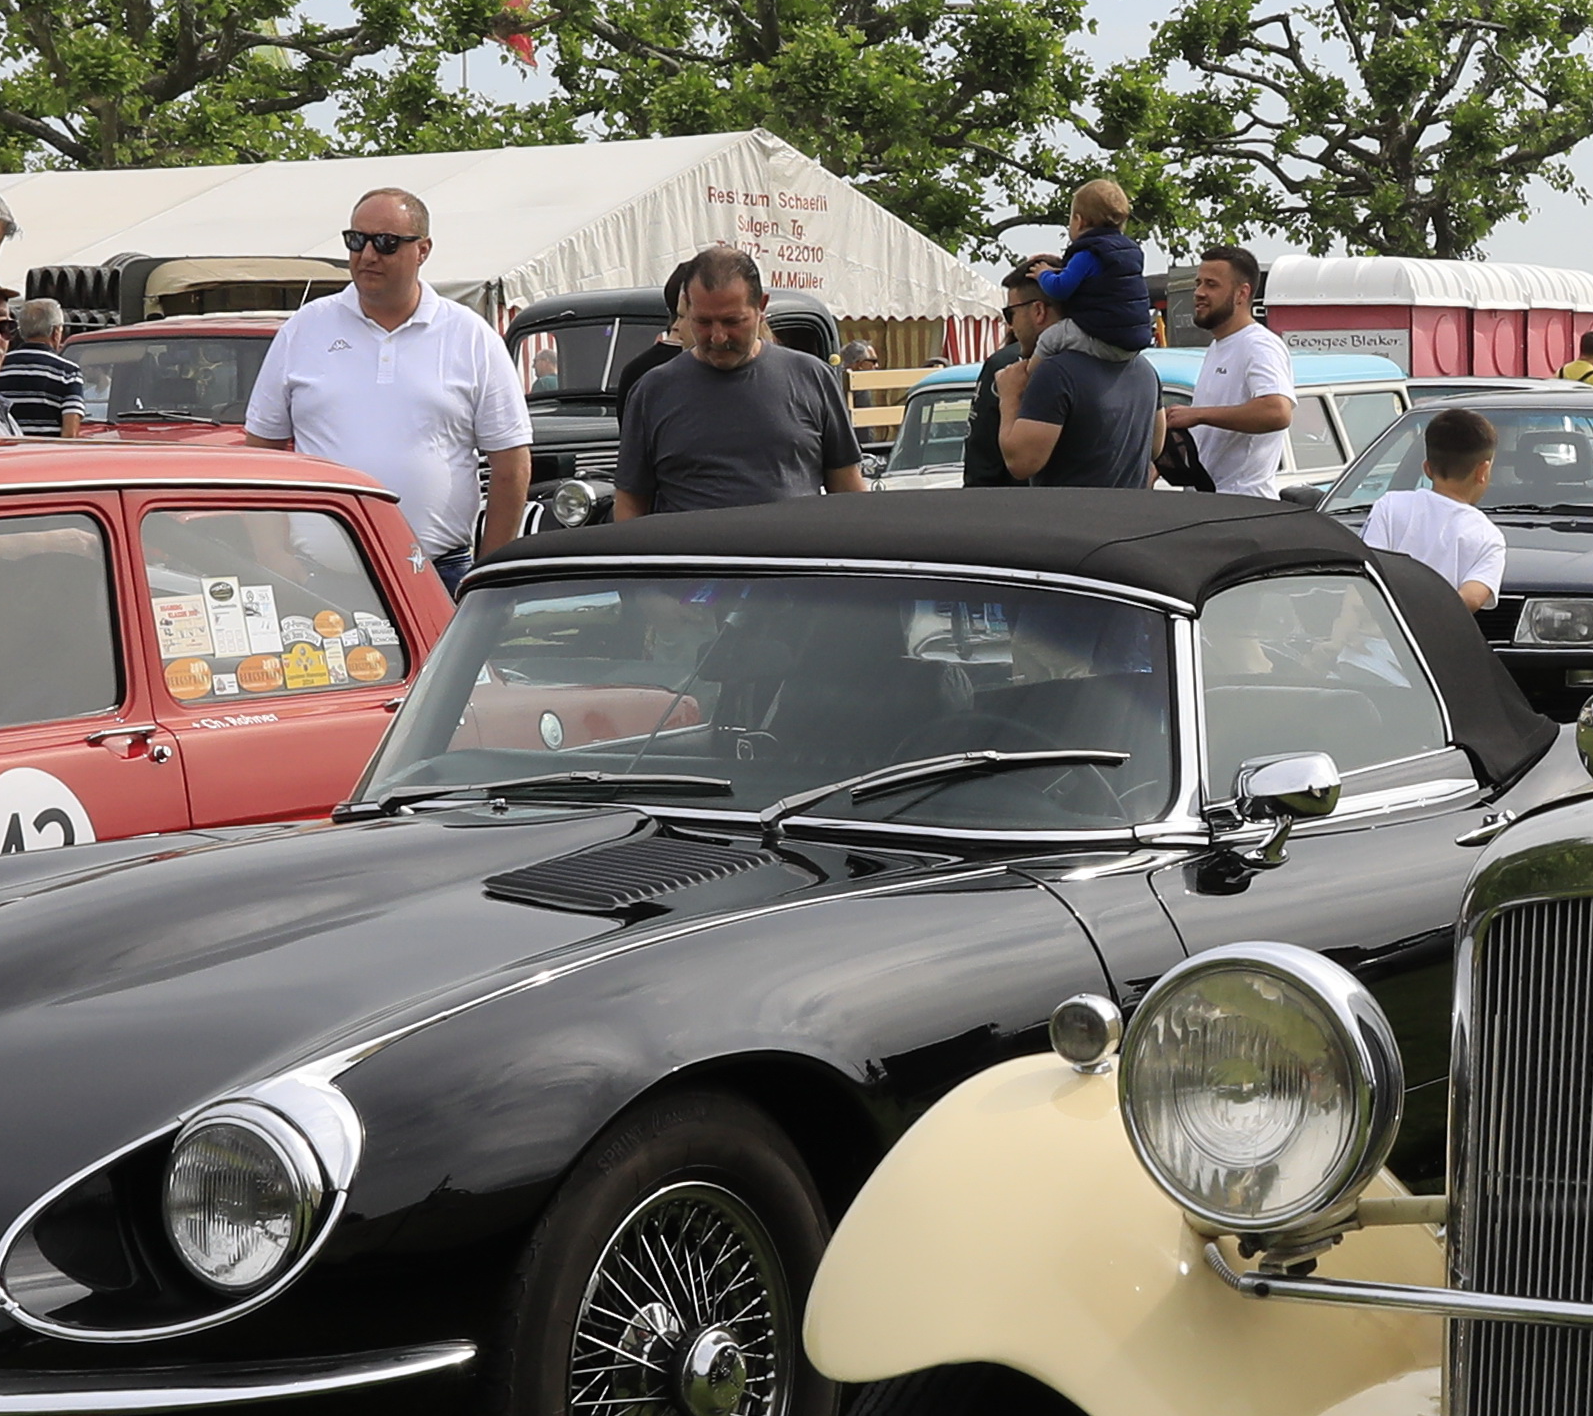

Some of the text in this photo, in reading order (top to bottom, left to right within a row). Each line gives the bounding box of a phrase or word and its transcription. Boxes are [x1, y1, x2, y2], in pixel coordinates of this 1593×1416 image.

[743, 192, 770, 207] zum
[737, 214, 779, 238] Sulgen
[777, 244, 824, 263] 422010
[1288, 334, 1348, 351] Georges
